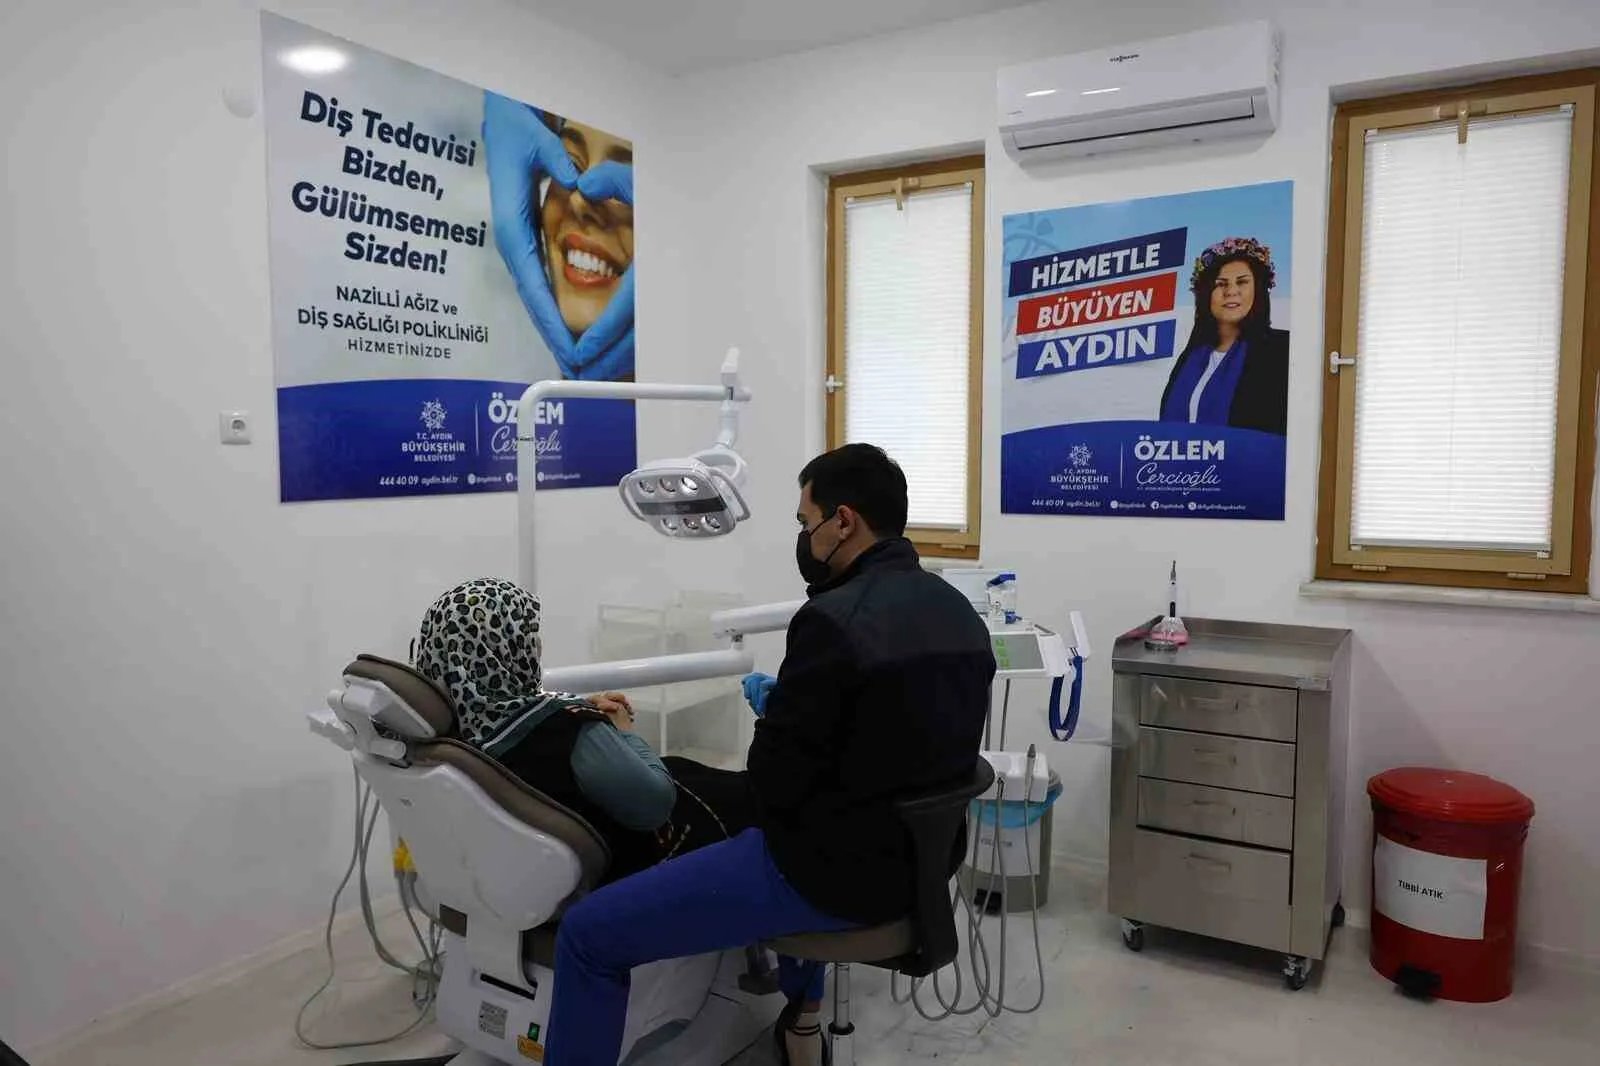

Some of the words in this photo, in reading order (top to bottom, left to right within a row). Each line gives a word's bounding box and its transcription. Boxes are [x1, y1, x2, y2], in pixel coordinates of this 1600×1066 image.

[300, 90, 353, 137] Diş
[362, 109, 477, 167] Tedavisi
[342, 146, 443, 201] Bizden,
[291, 182, 487, 248] Gülümsemesi
[344, 232, 447, 274] Sizden!
[1031, 243, 1161, 289] HİZMETLE
[336, 285, 400, 308] NAZİLLİ
[403, 293, 439, 314] AĞIZ
[442, 304, 458, 315] ve
[1036, 288, 1153, 329] BÜYÜYEN
[297, 307, 328, 329] DİŞ
[333, 311, 399, 334] SAĞLIĞI
[402, 322, 489, 344] POLİKLİNİĞİ
[347, 337, 452, 359] HİZMETİNİZDE
[1034, 325, 1157, 372] AYDIN
[488, 392, 564, 424] ÖZEM
[401, 440, 466, 453] BÜYÜKŞEHİR
[1134, 435, 1225, 461] ÖZLEM
[1050, 474, 1109, 484] BÜYÜKŞEHİR
[1136, 462, 1222, 488] Cercioğlu
[1421, 887, 1443, 899] ATIK
